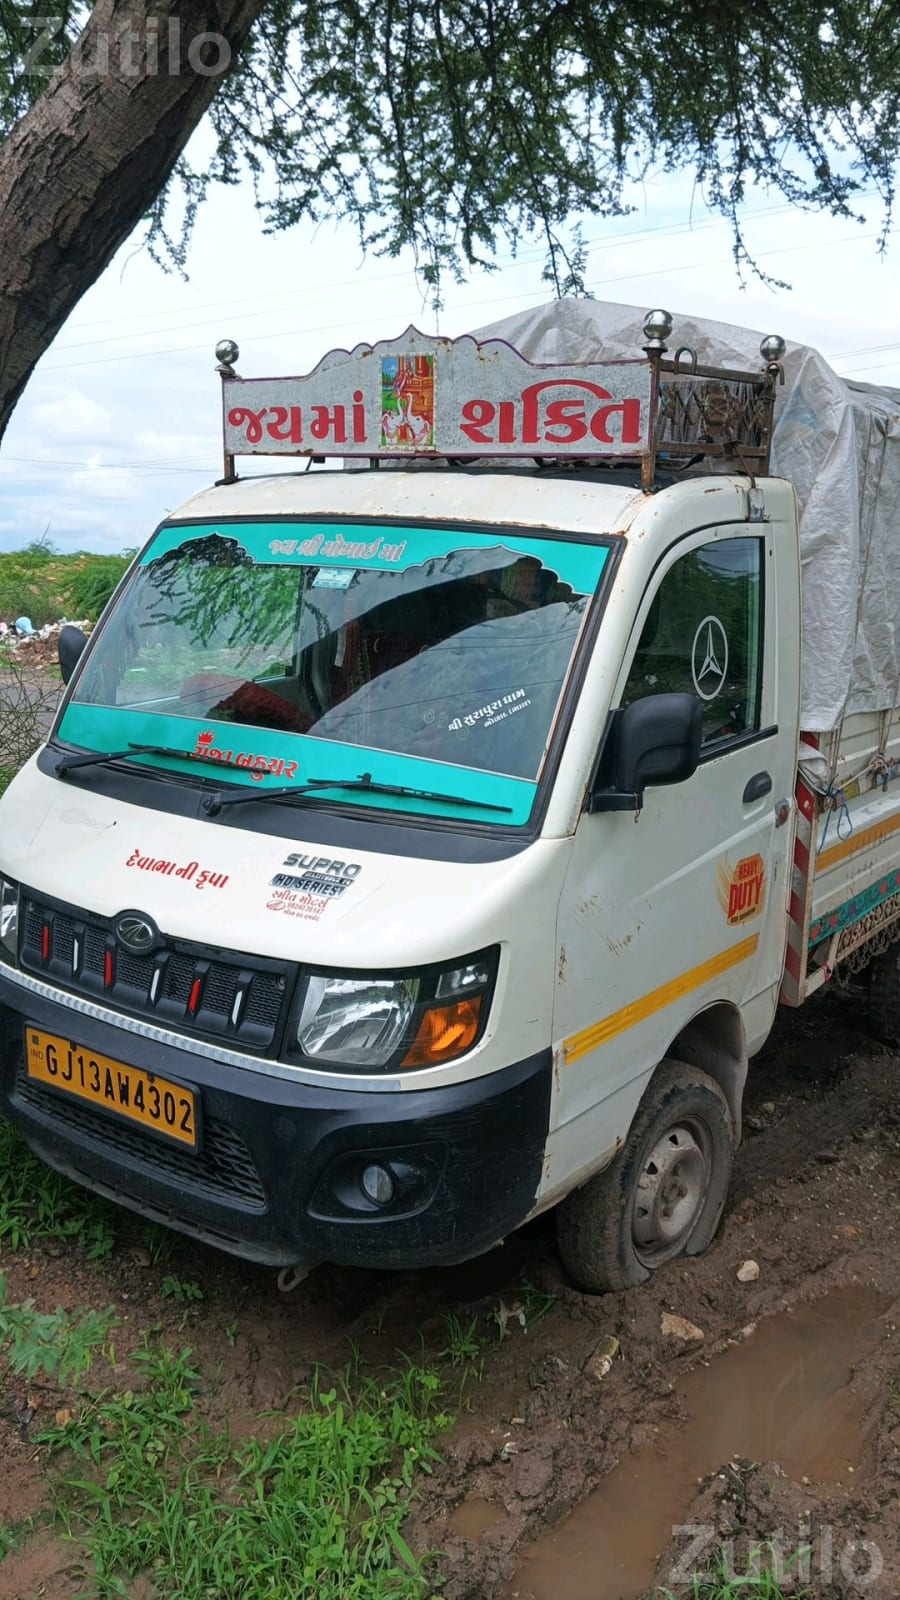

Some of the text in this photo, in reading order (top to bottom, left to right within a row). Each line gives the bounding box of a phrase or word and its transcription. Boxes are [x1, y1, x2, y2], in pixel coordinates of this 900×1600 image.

[448, 718, 463, 732] શ્રી
[282, 853, 362, 879] SUPRO
[276, 874, 293, 887] HD
[294, 878, 340, 897] SERIES
[727, 868, 765, 919] DUTY
[45, 1044, 193, 1134] GJ13AW4302
